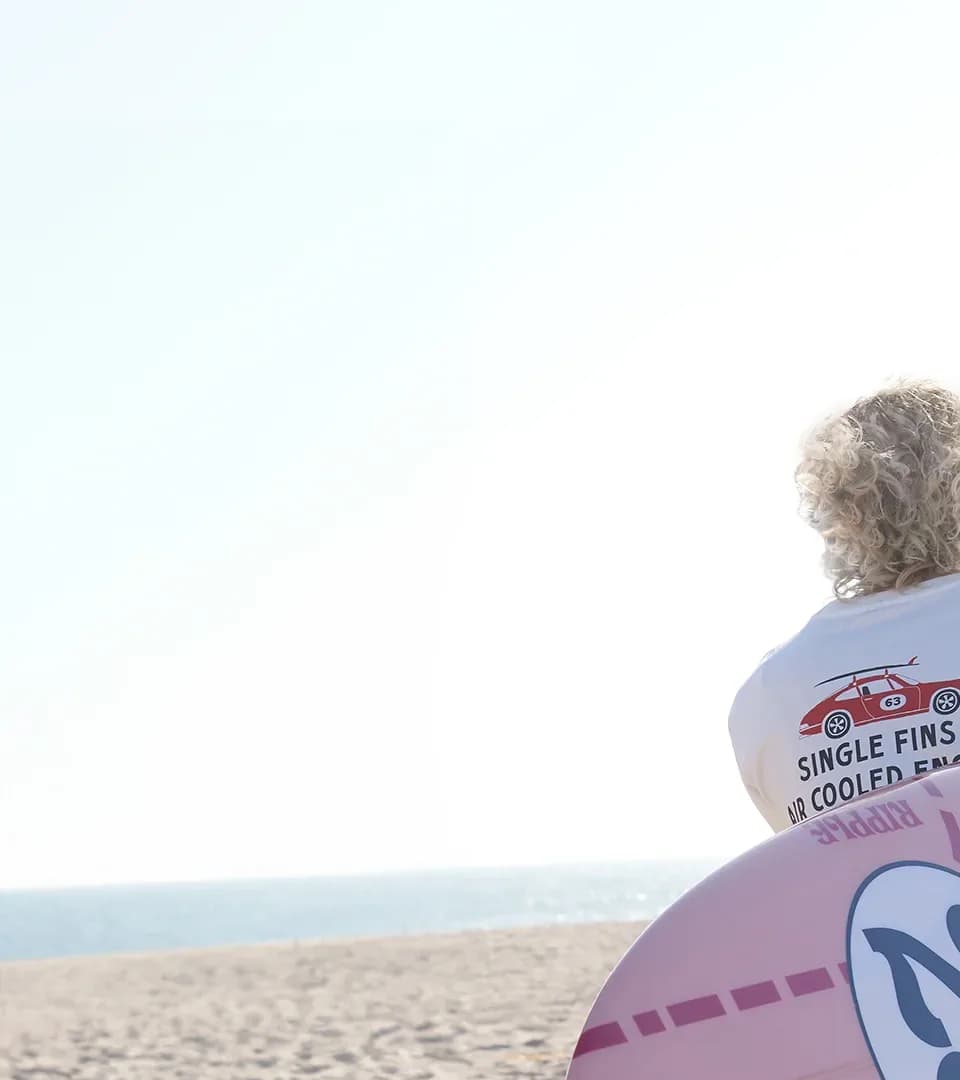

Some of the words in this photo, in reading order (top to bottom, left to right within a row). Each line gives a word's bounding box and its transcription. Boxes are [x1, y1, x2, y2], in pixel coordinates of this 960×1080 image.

[884, 696, 902, 708] 63
[797, 733, 885, 782] SINGLE
[894, 720, 957, 755] FINS
[787, 796, 808, 825] AIR
[811, 765, 904, 812] COOLED
[809, 799, 925, 846] RIPPLE
